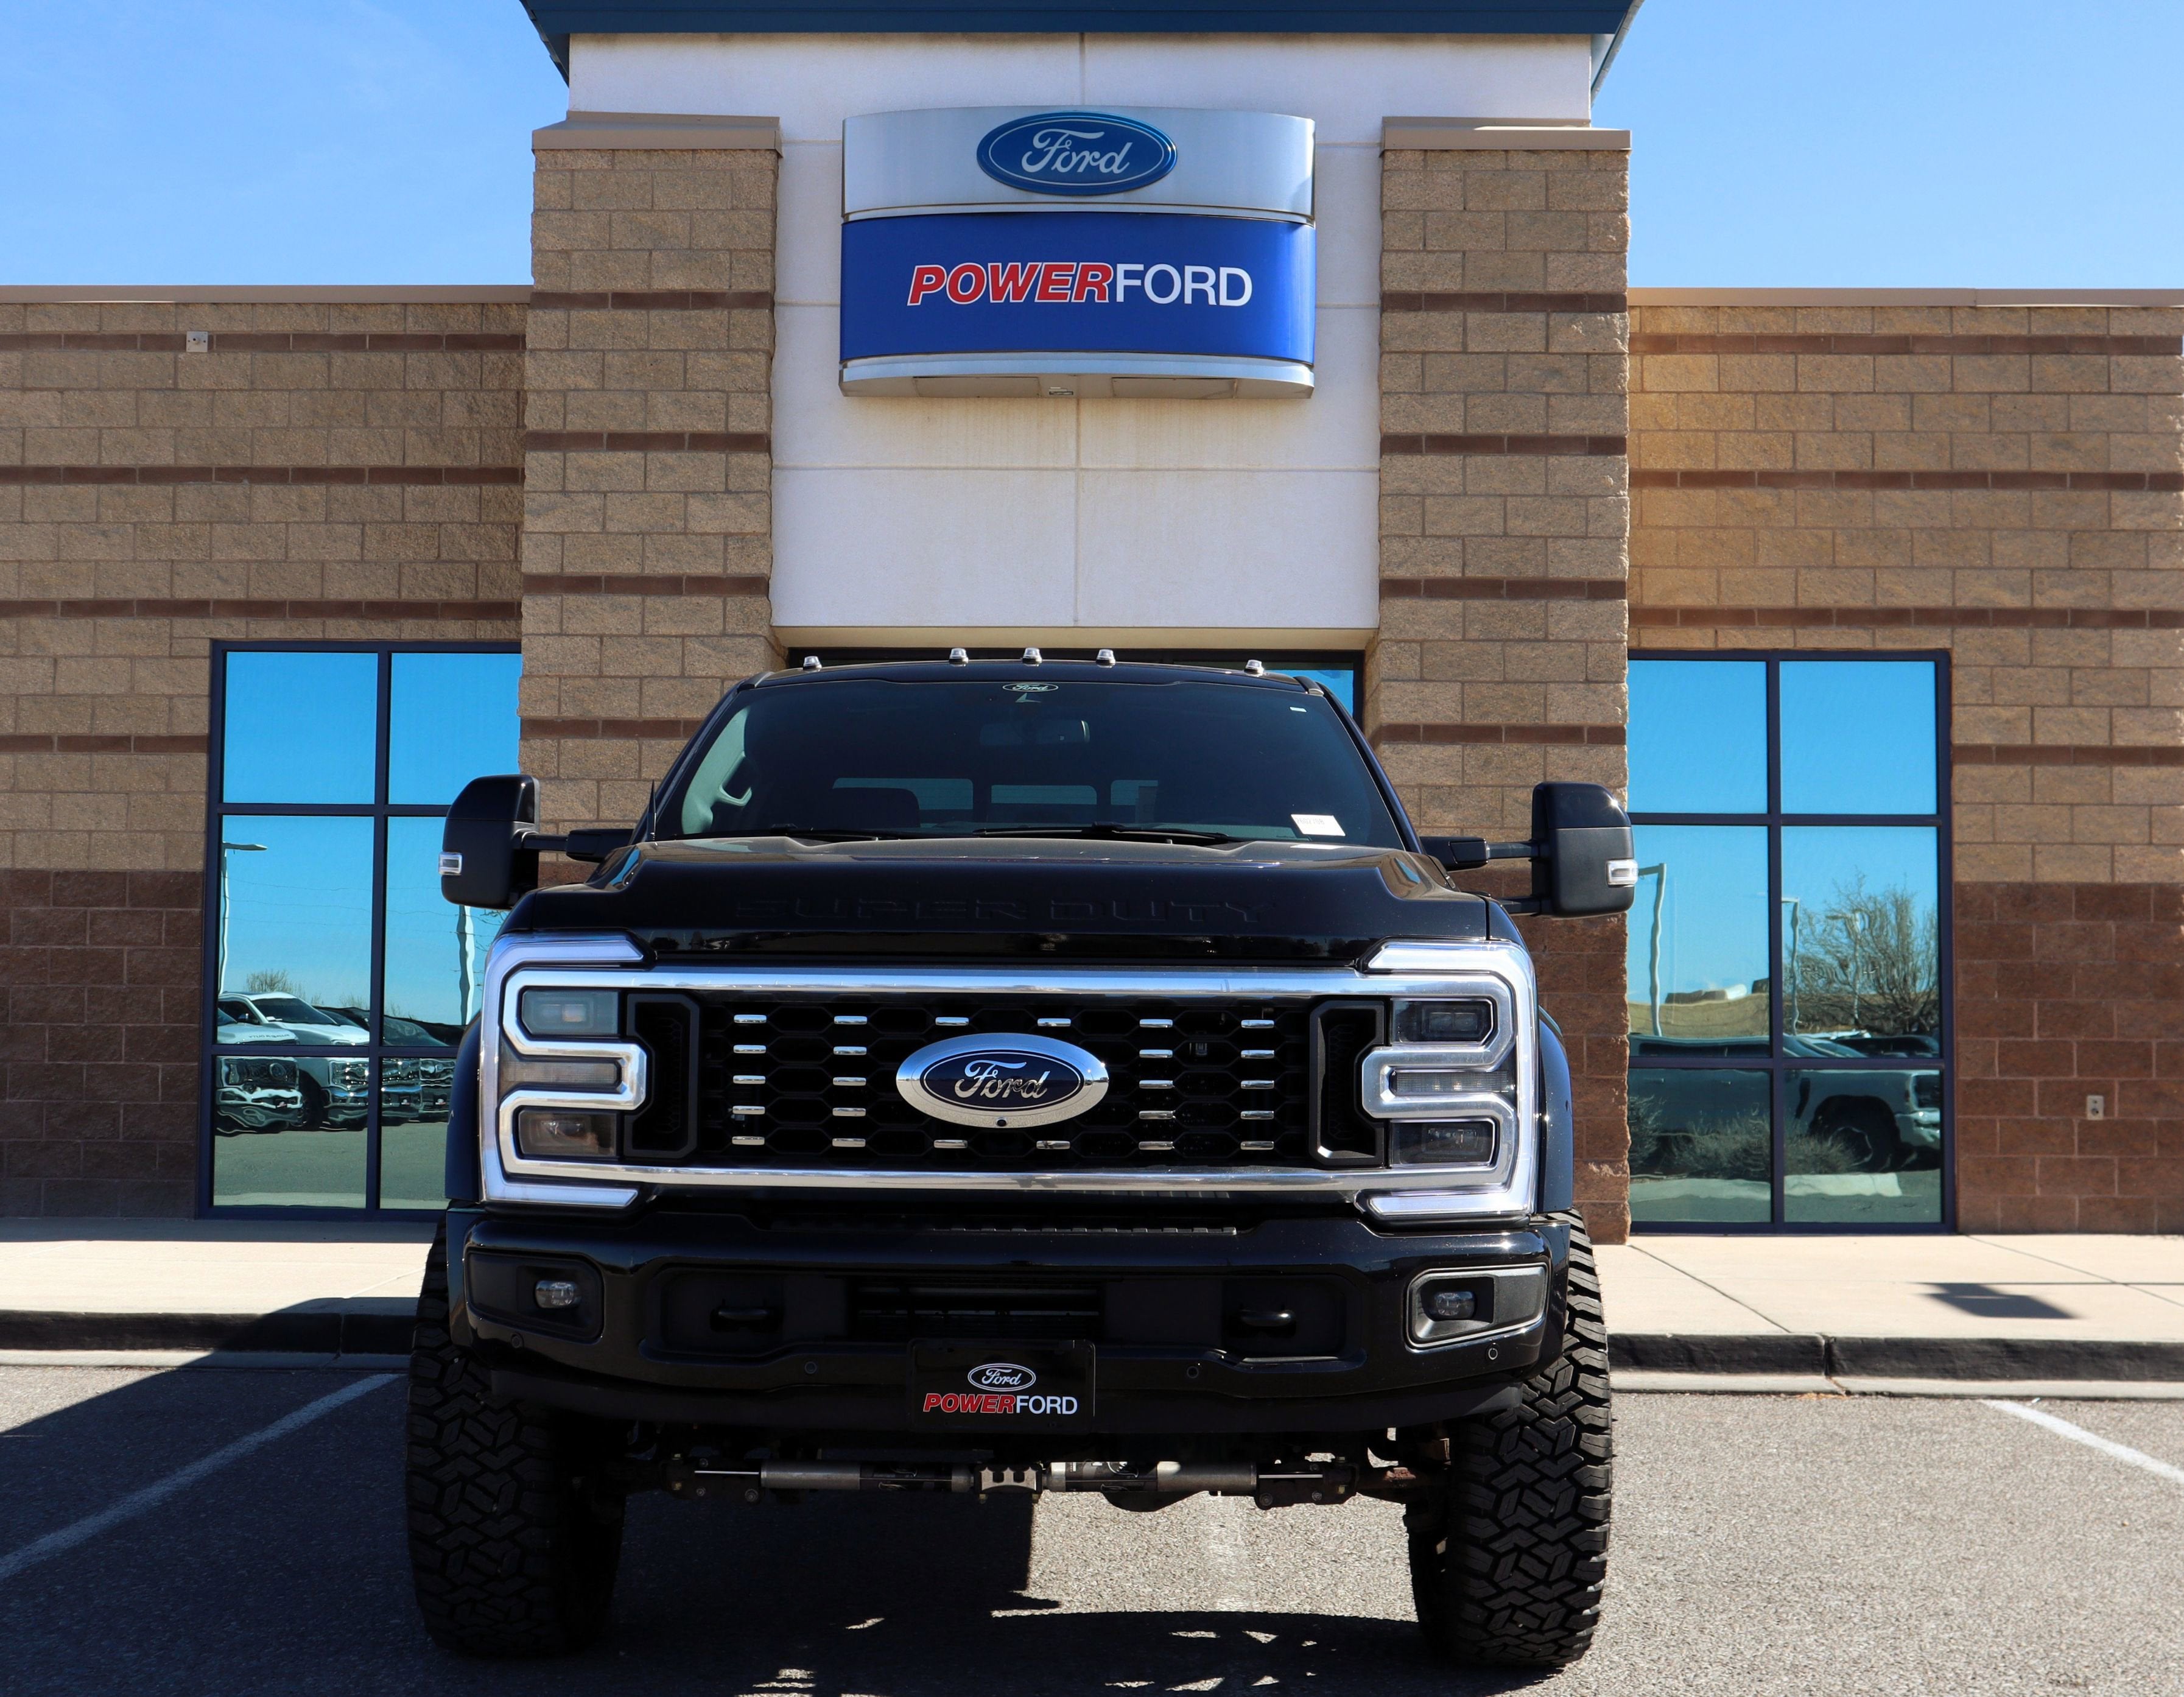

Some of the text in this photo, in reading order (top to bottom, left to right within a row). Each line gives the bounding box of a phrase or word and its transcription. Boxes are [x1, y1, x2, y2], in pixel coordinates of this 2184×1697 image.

[1022, 128, 1130, 175] Ford
[907, 262, 1252, 306] POWERFORD
[736, 898, 1276, 923] SUPER DUTY
[955, 1059, 1050, 1098] Ford
[981, 1368, 1021, 1385] Ford
[923, 1393, 1078, 1414] POWERFORD
